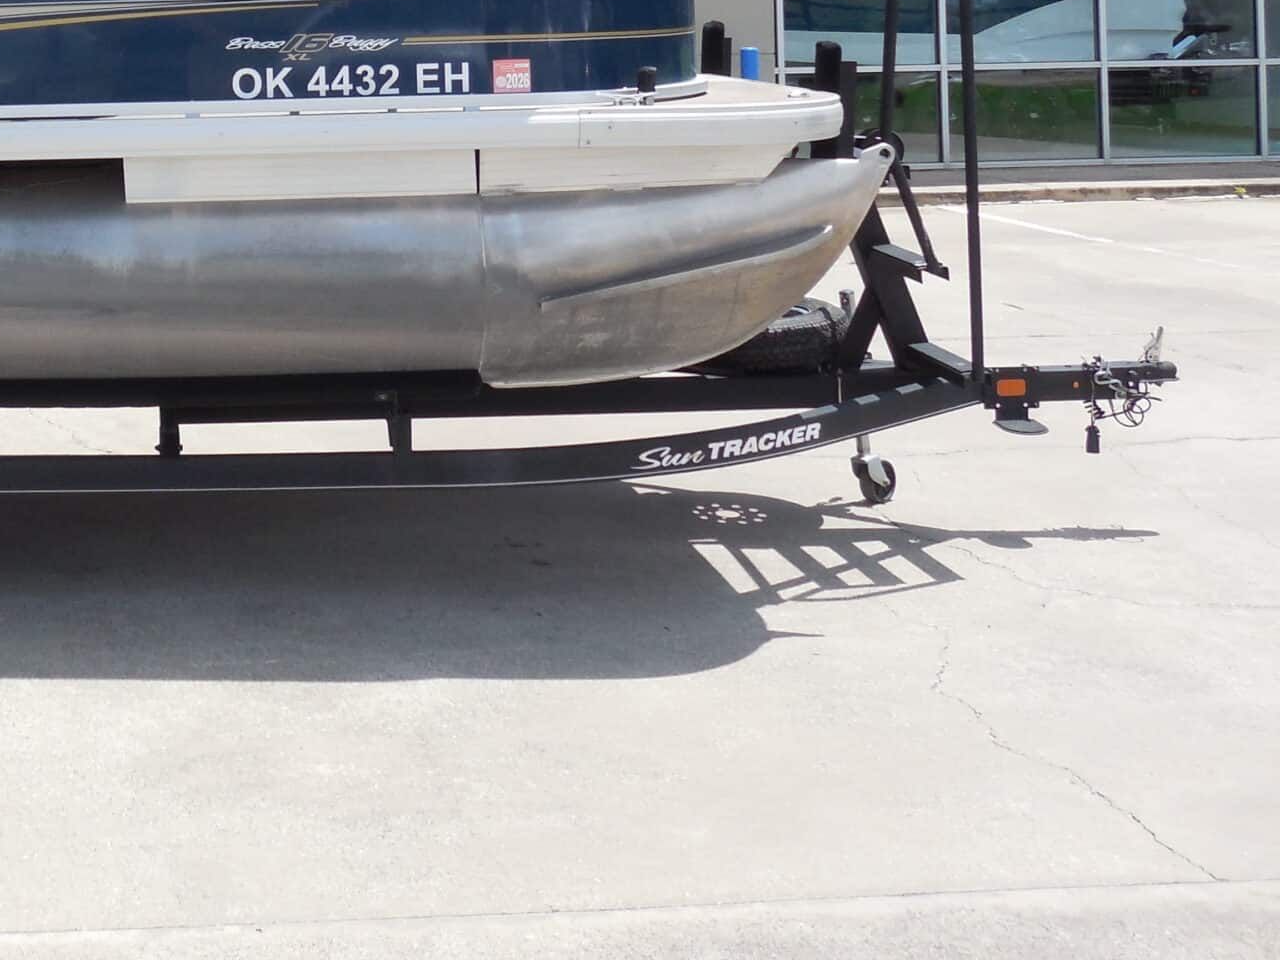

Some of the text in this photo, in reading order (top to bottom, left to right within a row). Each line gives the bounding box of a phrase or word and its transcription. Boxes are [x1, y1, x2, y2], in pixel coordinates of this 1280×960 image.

[225, 33, 400, 53] Bass 16 Buggy
[282, 53, 312, 61] XL
[232, 62, 470, 99] OK 4432 EH
[630, 422, 822, 470] Sun TRACKER
